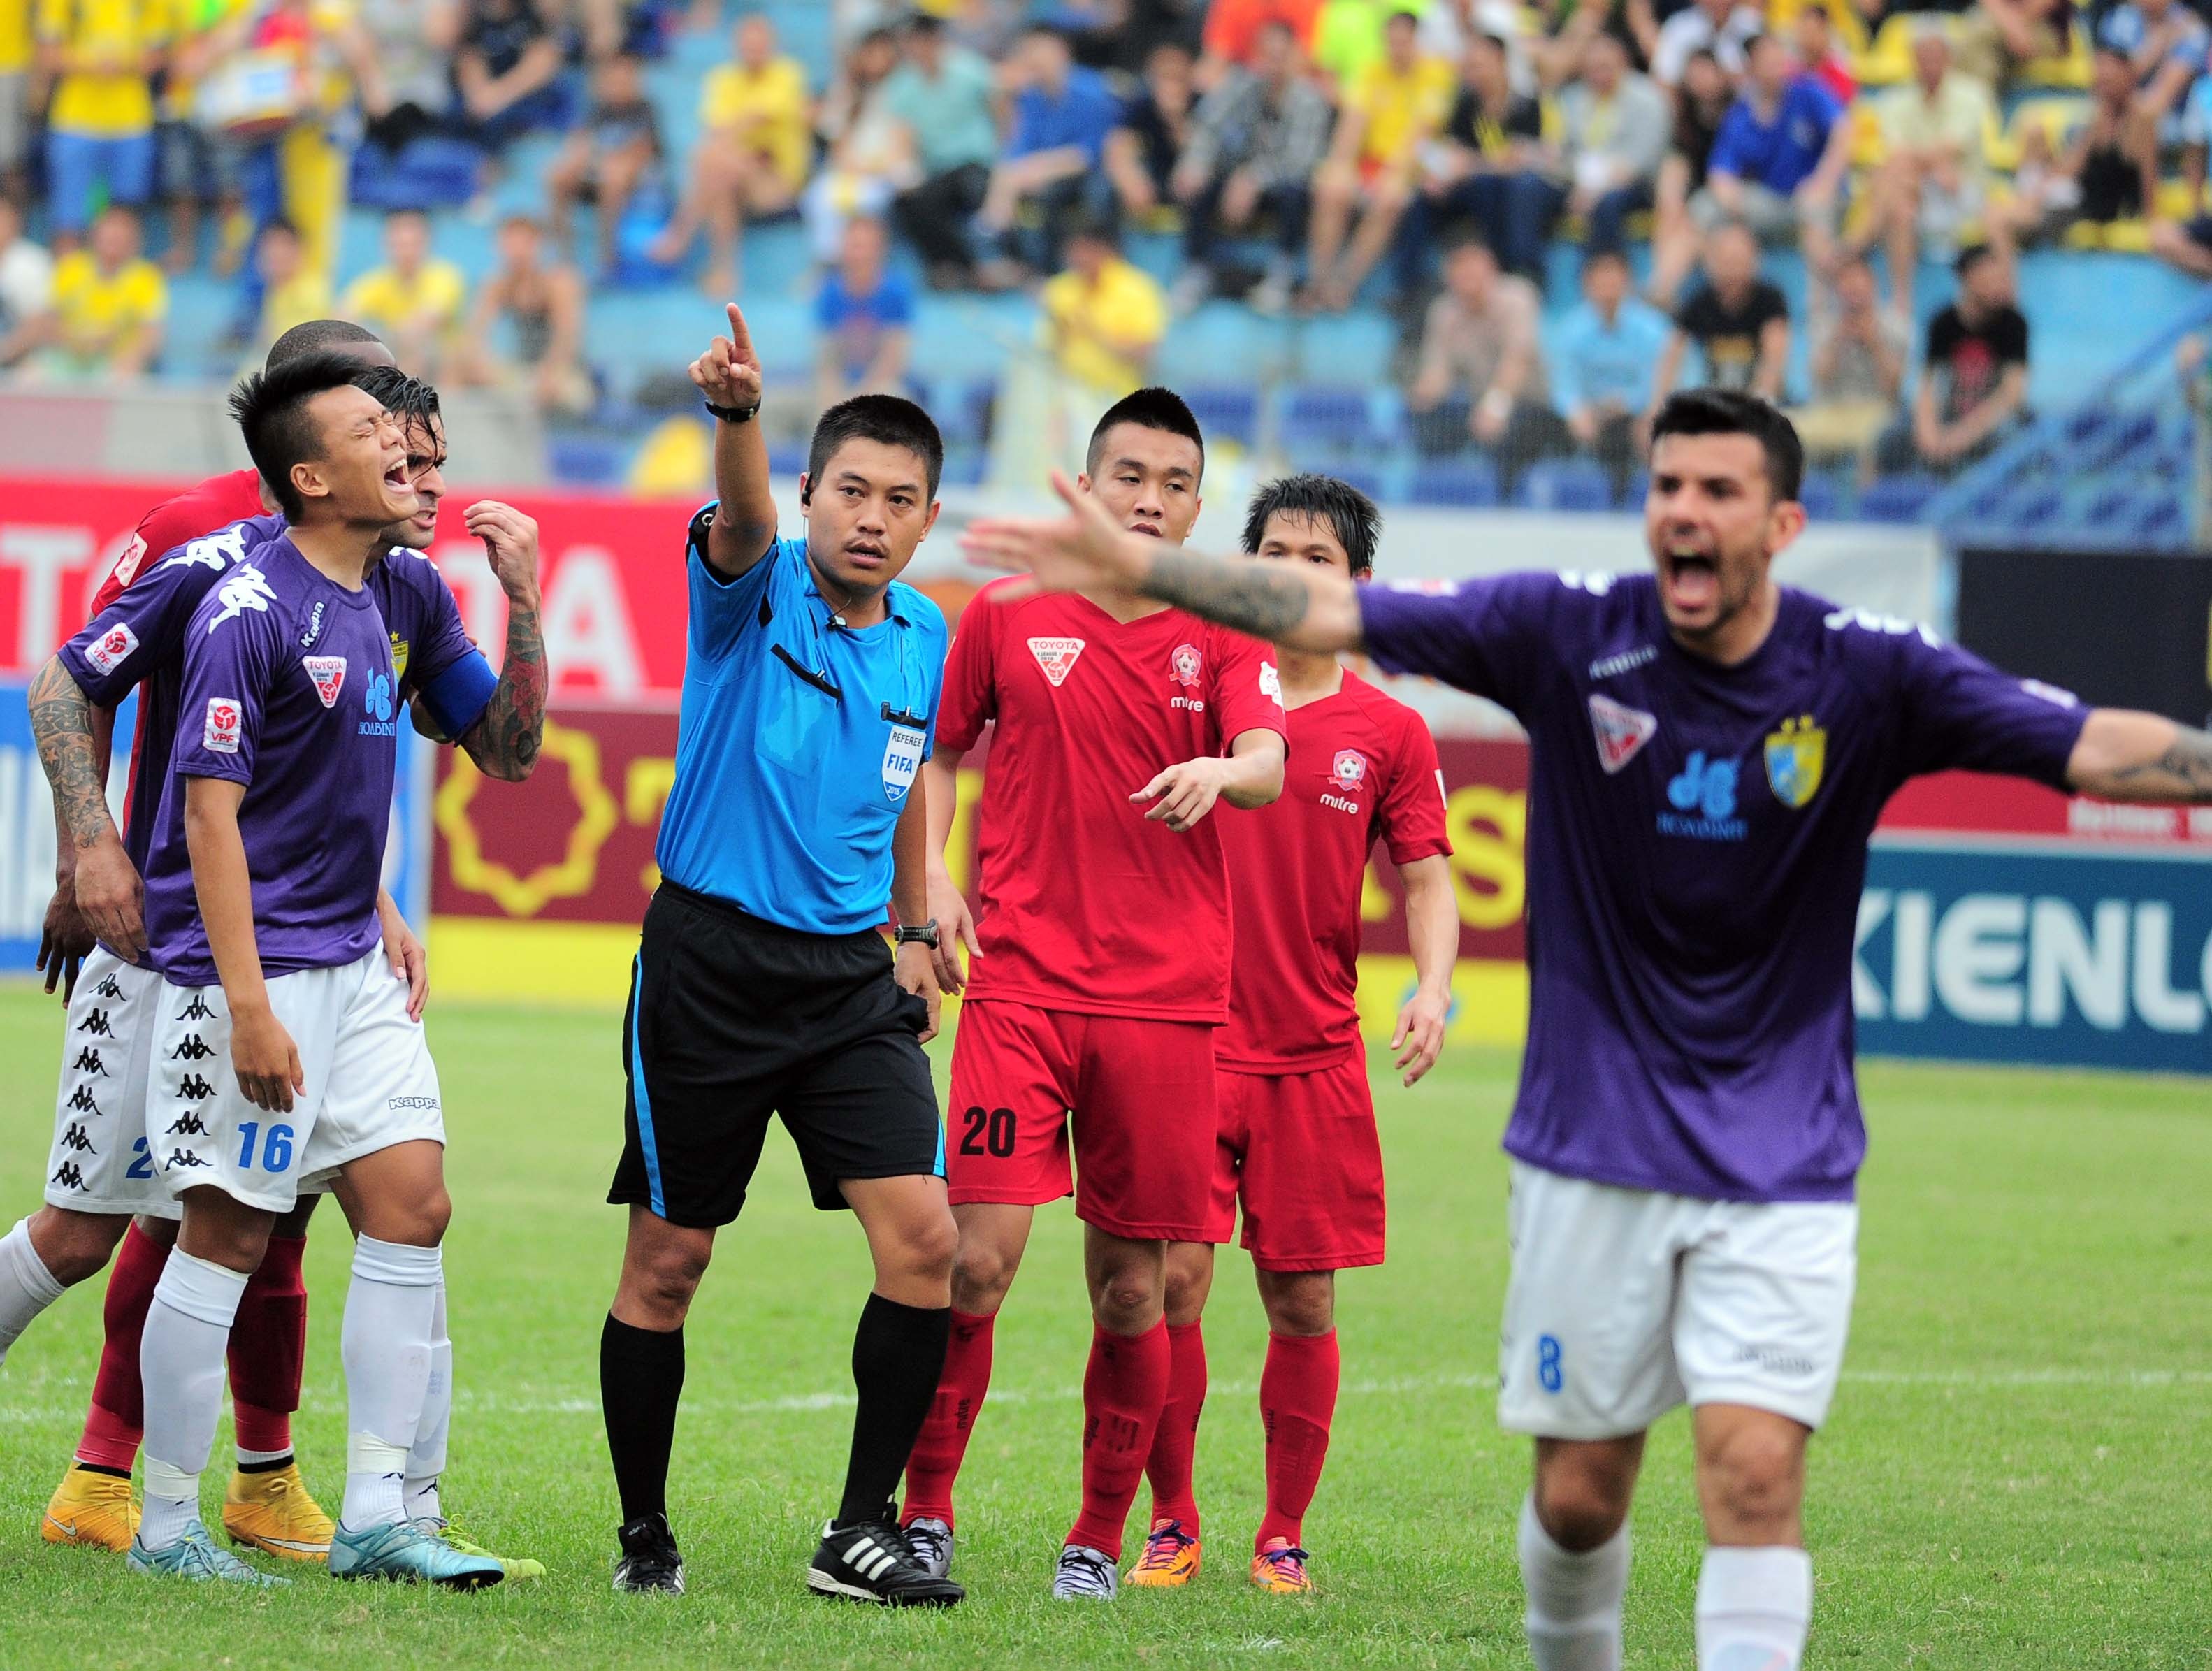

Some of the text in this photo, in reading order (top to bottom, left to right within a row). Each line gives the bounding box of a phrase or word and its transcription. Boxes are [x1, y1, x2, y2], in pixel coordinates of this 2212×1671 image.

[301, 600, 325, 647] Kappa
[93, 646, 111, 665] VPF
[1033, 640, 1079, 650] TOYOTA
[308, 660, 342, 670] TOYOTA
[211, 732, 234, 743] VPF
[892, 732, 923, 748] REFEREE
[886, 753, 914, 774] FIFA
[1320, 793, 1359, 814] mitre
[960, 1106, 1017, 1158] 20
[238, 1122, 294, 1173] 16
[1538, 1333, 1561, 1393] 8
